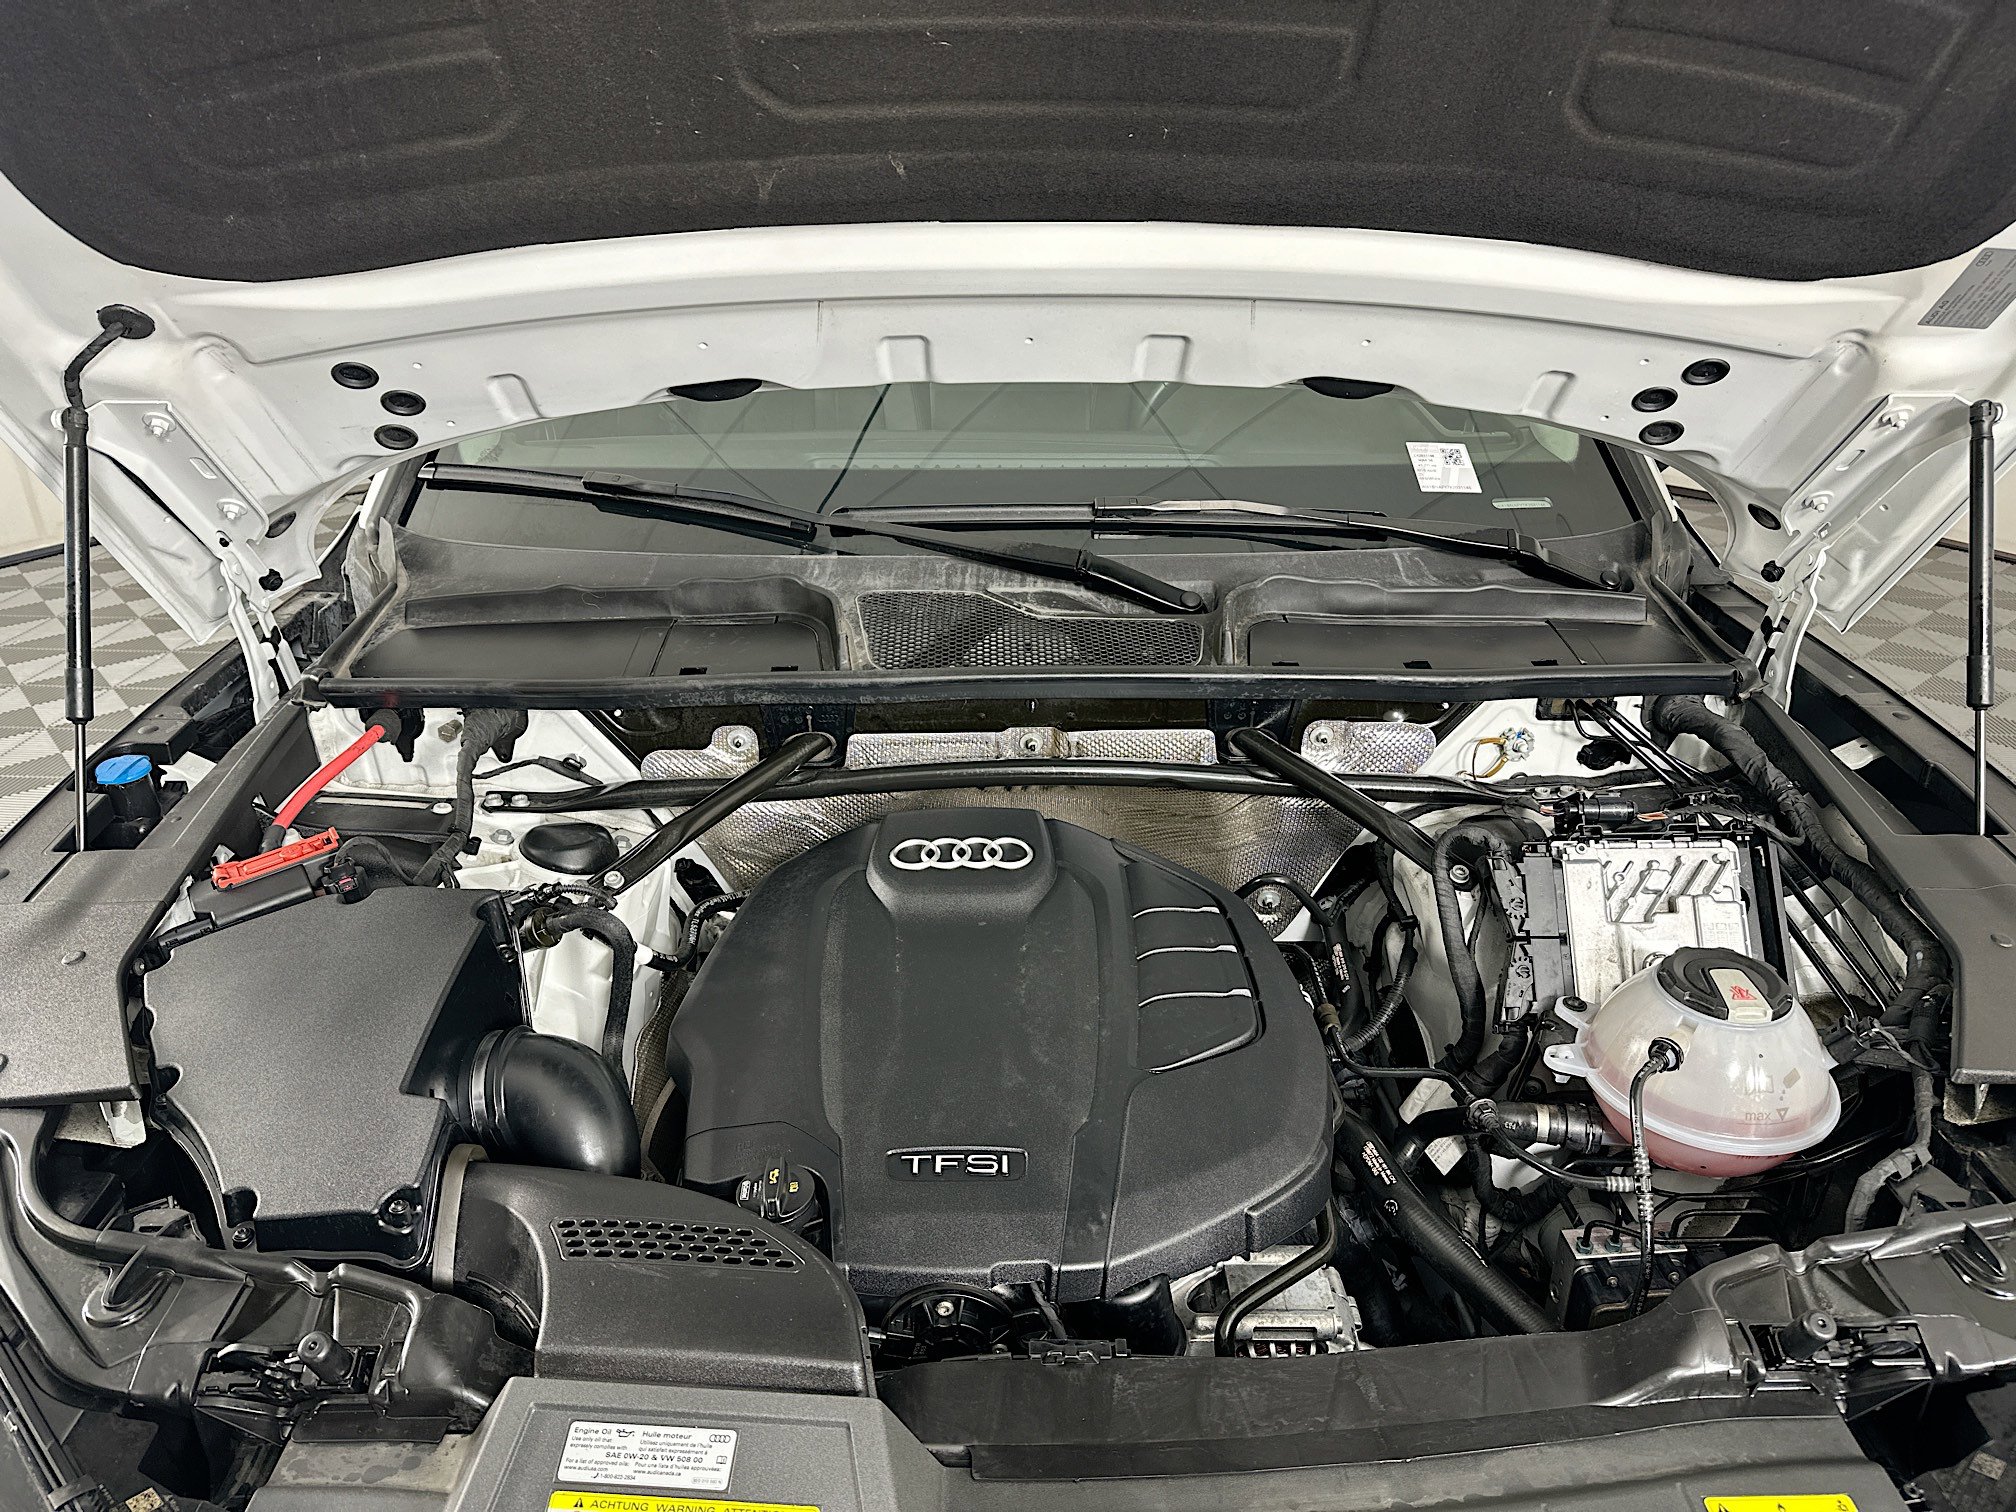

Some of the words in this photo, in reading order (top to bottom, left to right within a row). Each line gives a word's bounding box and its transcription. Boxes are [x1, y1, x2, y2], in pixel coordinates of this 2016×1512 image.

[1745, 1111, 1772, 1121] max
[900, 1154, 1010, 1176] TFSI
[574, 1427, 600, 1435] Engine
[642, 1430, 661, 1438] Huile
[663, 1432, 692, 1440] moteur
[660, 1454, 675, 1462] VW
[676, 1455, 691, 1463] 508
[590, 1500, 649, 1512] ACHTUNG
[656, 1504, 715, 1512] WARNING
